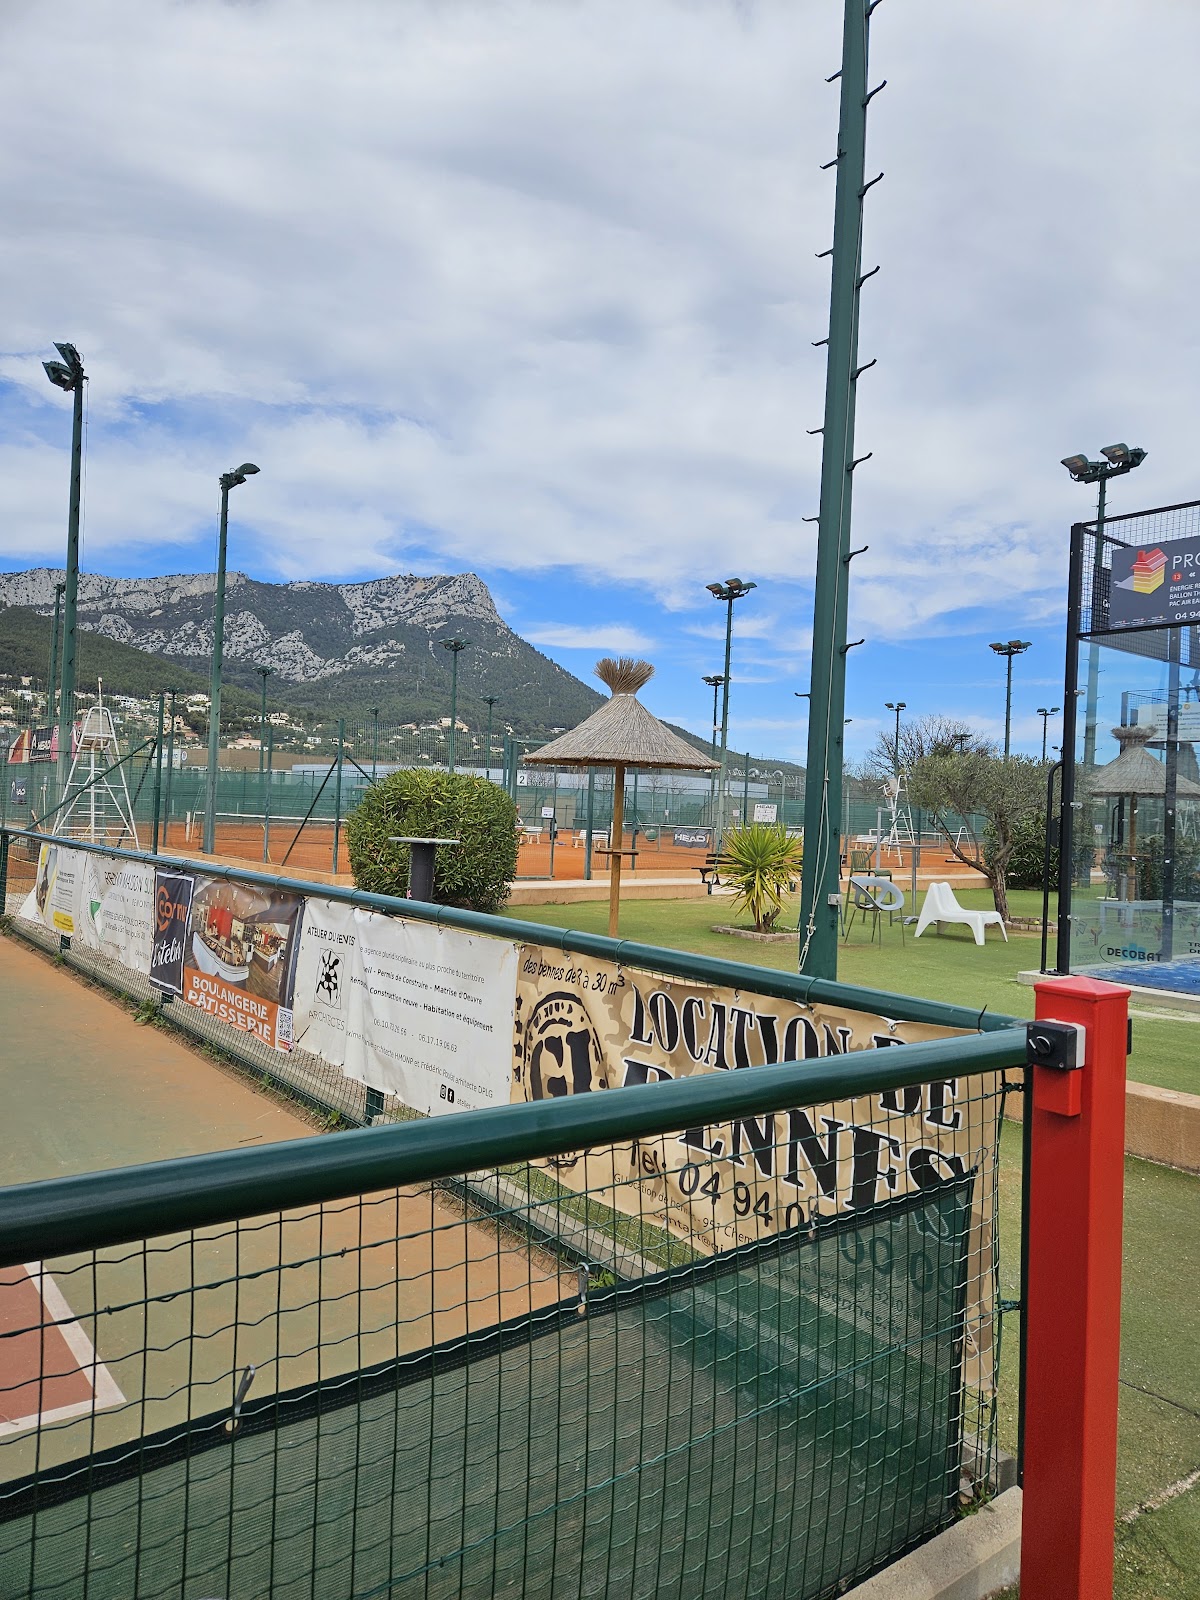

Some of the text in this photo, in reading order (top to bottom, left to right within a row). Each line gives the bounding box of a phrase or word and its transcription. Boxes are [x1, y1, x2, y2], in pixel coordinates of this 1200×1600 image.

[1175, 612, 1188, 620] 04
[520, 776, 525, 784] 2
[674, 834, 706, 842] HEAD
[1107, 947, 1163, 961] DECOBAT
[364, 947, 381, 956] agence
[425, 962, 435, 971] plus
[437, 965, 455, 976] proche
[461, 972, 485, 984] territoire
[523, 954, 538, 974] des
[538, 950, 564, 980] bennes
[583, 970, 589, 989] à
[592, 972, 607, 992] 30
[377, 969, 394, 980] Permis
[395, 973, 401, 982] de
[192, 976, 268, 1020] BOULANGERIE
[188, 990, 272, 1042] PÂTISSERIE
[402, 998, 418, 1008] neuve
[423, 1003, 454, 1019] Habitation
[456, 1012, 462, 1020] et
[462, 1014, 493, 1032] équipement
[478, 1086, 493, 1099] DPLG
[678, 1162, 721, 1206] 04
[733, 1181, 773, 1228] 94
[724, 1226, 757, 1244] Chemi
